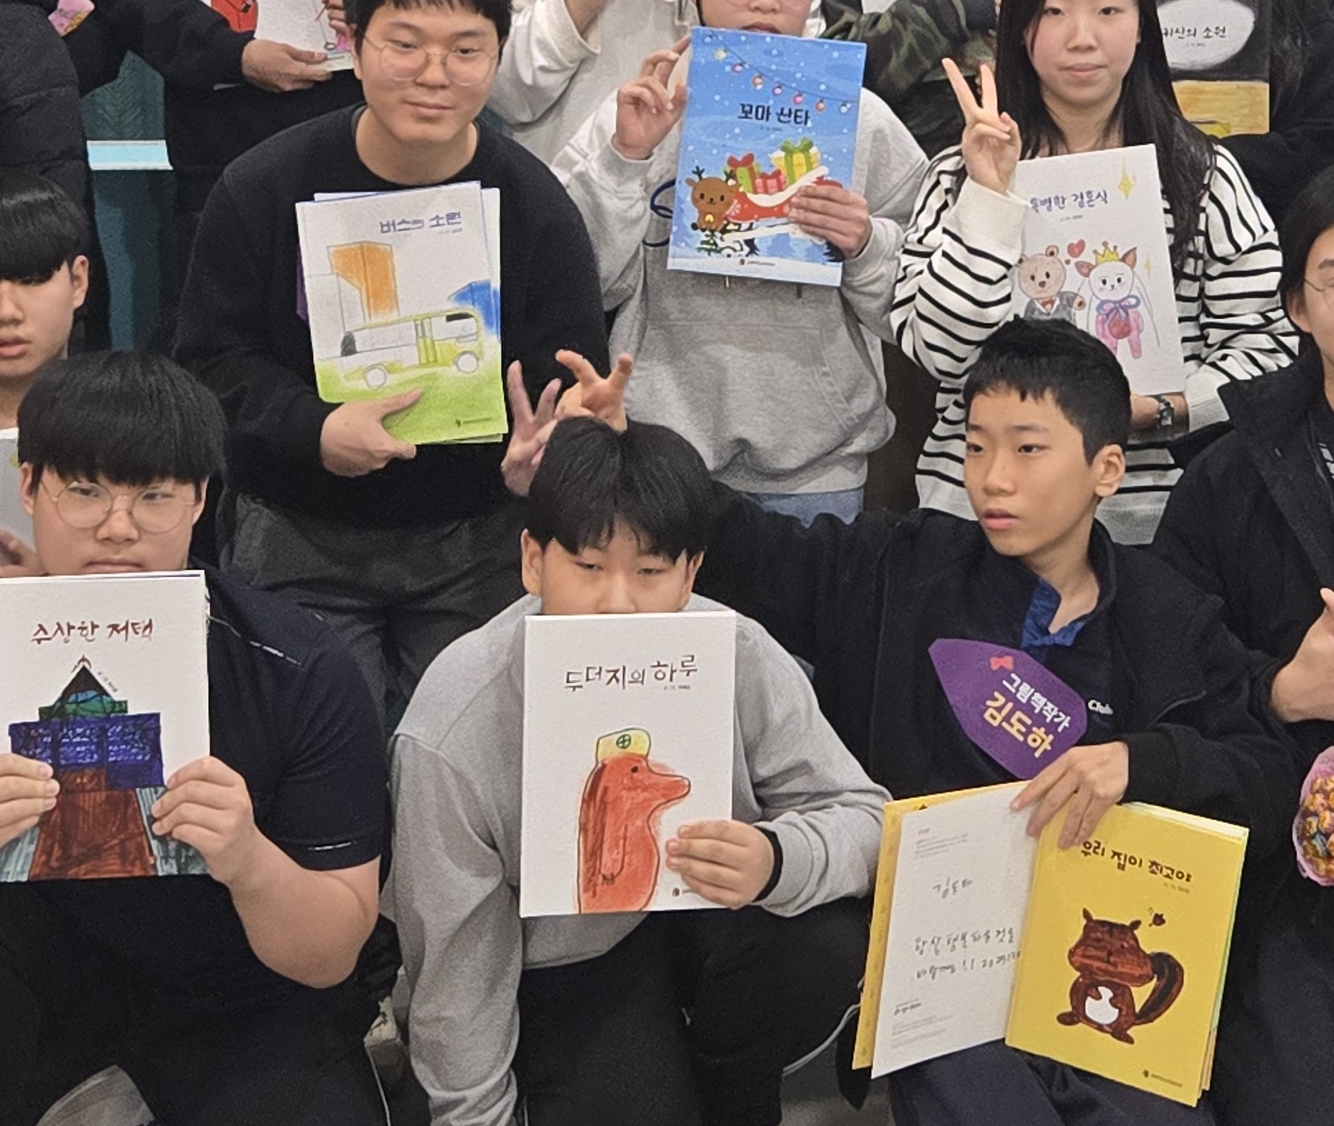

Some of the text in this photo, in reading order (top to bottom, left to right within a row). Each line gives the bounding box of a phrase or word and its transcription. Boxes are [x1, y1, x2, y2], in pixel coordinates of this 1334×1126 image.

[1203, 25, 1228, 39] 소원
[737, 103, 811, 126] 꼬마 산타
[1071, 189, 1108, 209] 결혼식
[379, 218, 425, 234] 버스의
[31, 619, 154, 645] 수상한 저택
[564, 654, 699, 692] 두더지의 하루
[983, 691, 1054, 759] 김도하
[1081, 840, 1192, 882] 우리 집이 최고야
